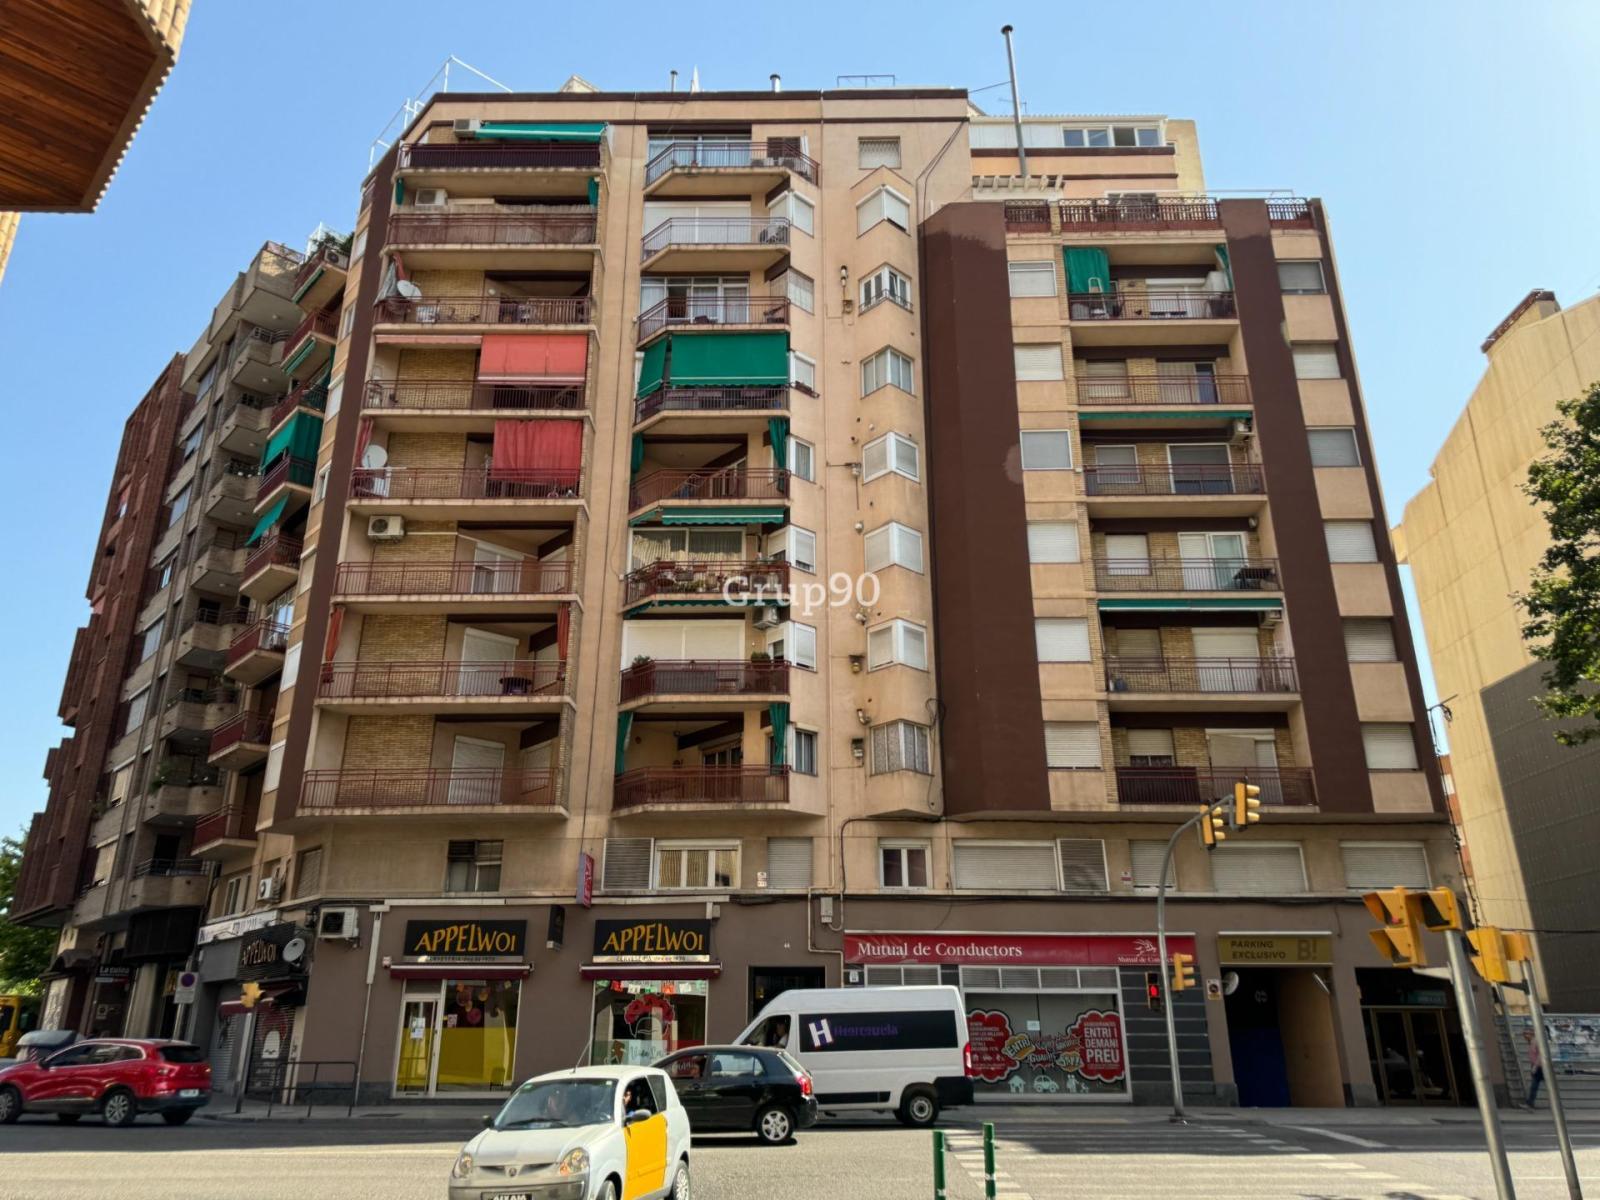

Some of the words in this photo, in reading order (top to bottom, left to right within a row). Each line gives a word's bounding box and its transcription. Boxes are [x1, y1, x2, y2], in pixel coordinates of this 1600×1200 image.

[414, 923, 516, 952] APPELWOI
[602, 923, 703, 951] APPELWOI
[1230, 940, 1274, 948] PARKING
[858, 942, 907, 956] Mutual
[913, 942, 931, 956] de
[935, 942, 1023, 957] Conductors
[1232, 951, 1286, 960] EXCLUSIVO
[808, 1018, 834, 1047] H
[1084, 1027, 1112, 1038] ENTRI
[1005, 1038, 1031, 1058] ENTRI
[1085, 1038, 1119, 1049] DEMANI
[1087, 1049, 1120, 1063] PREU
